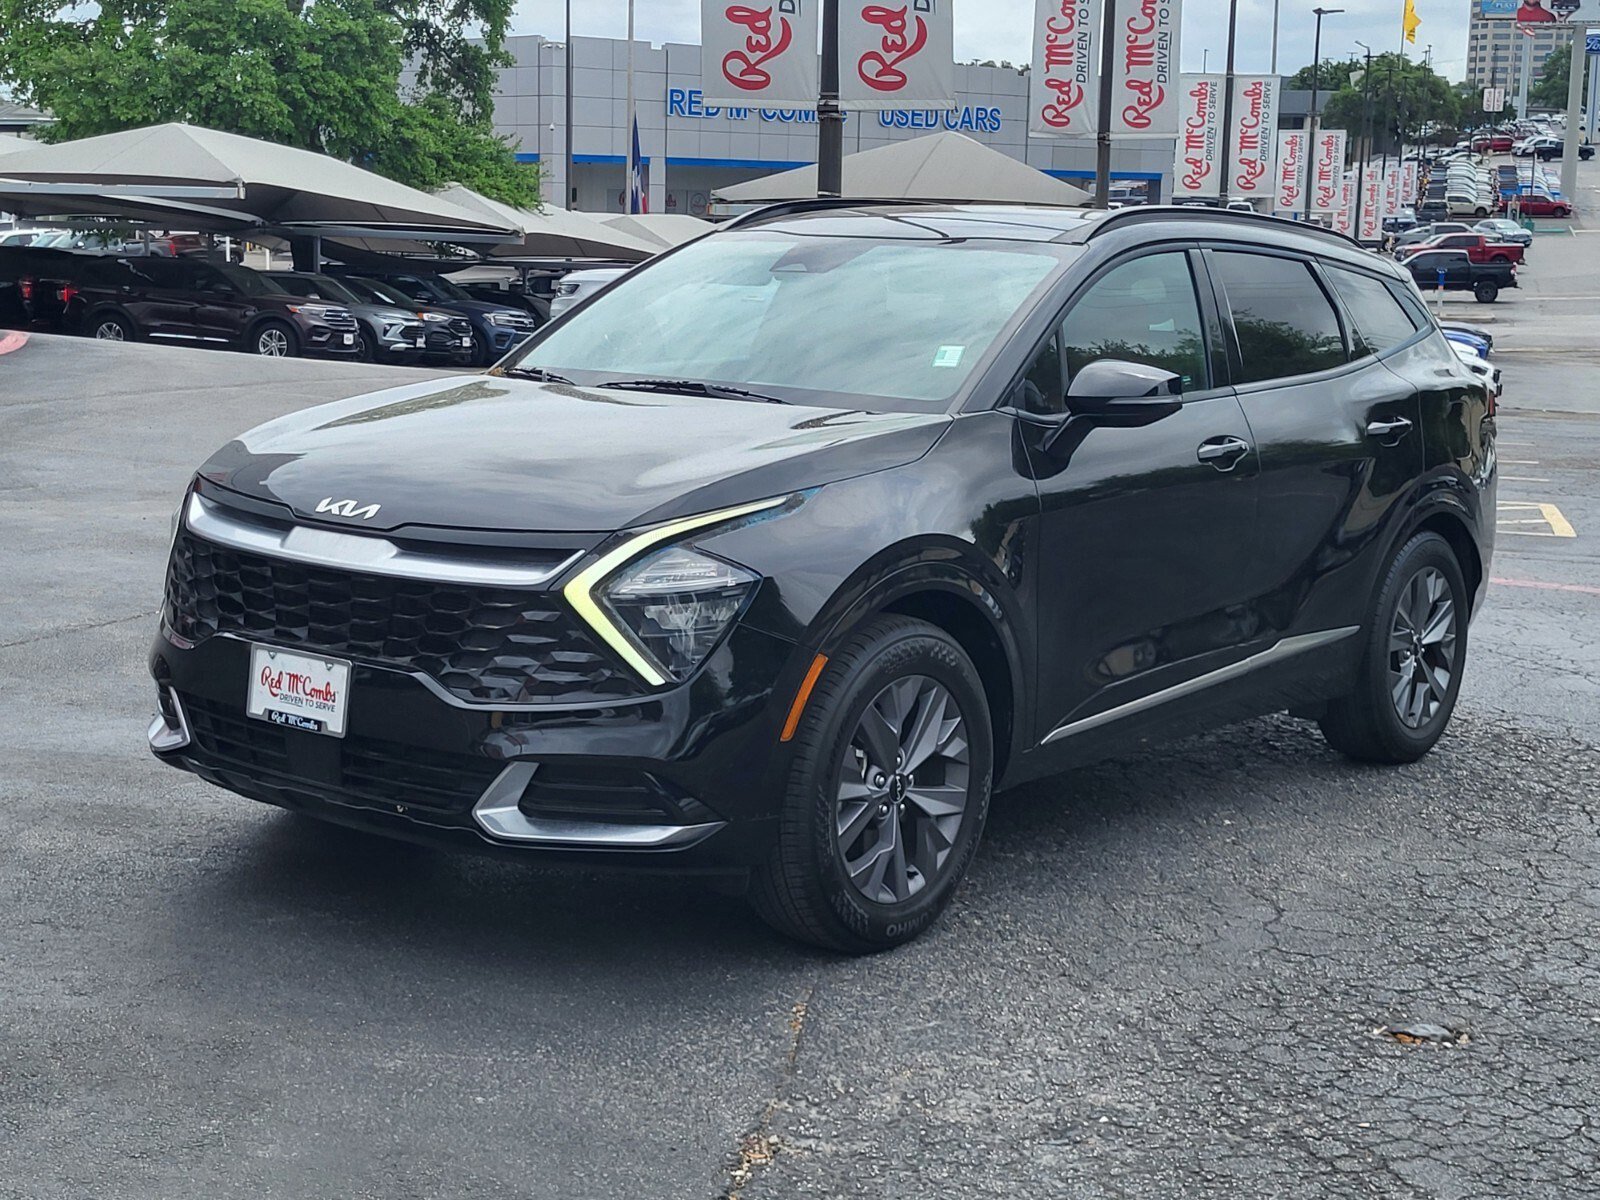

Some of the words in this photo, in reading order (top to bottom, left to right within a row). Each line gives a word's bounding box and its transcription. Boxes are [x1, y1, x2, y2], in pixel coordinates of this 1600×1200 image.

[1078, 8, 1089, 28] TO
[1159, 8, 1170, 28] TO
[722, 5, 793, 91] Red
[857, 4, 928, 92] Red
[1075, 31, 1089, 84] DRIVEN
[1156, 31, 1169, 84] DRIVEN
[1041, 78, 1084, 128] Red
[1122, 79, 1165, 129] Red
[1209, 81, 1218, 110] SERVE
[1262, 81, 1272, 110] SERVE
[881, 109, 938, 128] USED
[945, 106, 1001, 131] CARS
[1184, 81, 1209, 155] McCombs
[1208, 111, 1216, 125] TO
[1238, 81, 1263, 155] McCombs
[1262, 111, 1270, 125] TO
[1205, 127, 1215, 161] DRIVEN
[1260, 127, 1269, 161] DRIVEN
[1281, 135, 1298, 183] McCombs
[1318, 135, 1334, 184] McCombs
[1181, 157, 1211, 190] Red
[1236, 158, 1265, 190] Red
[1279, 185, 1300, 207] Red
[1315, 186, 1336, 208] Red
[315, 496, 381, 520] KIA
[261, 665, 283, 698] Red
[285, 670, 336, 704] McCombs
[279, 692, 304, 706] DRIVEN
[305, 699, 315, 708] TO
[315, 700, 336, 713] SERVE
[271, 711, 287, 724] Red
[287, 714, 318, 731] McCombs
